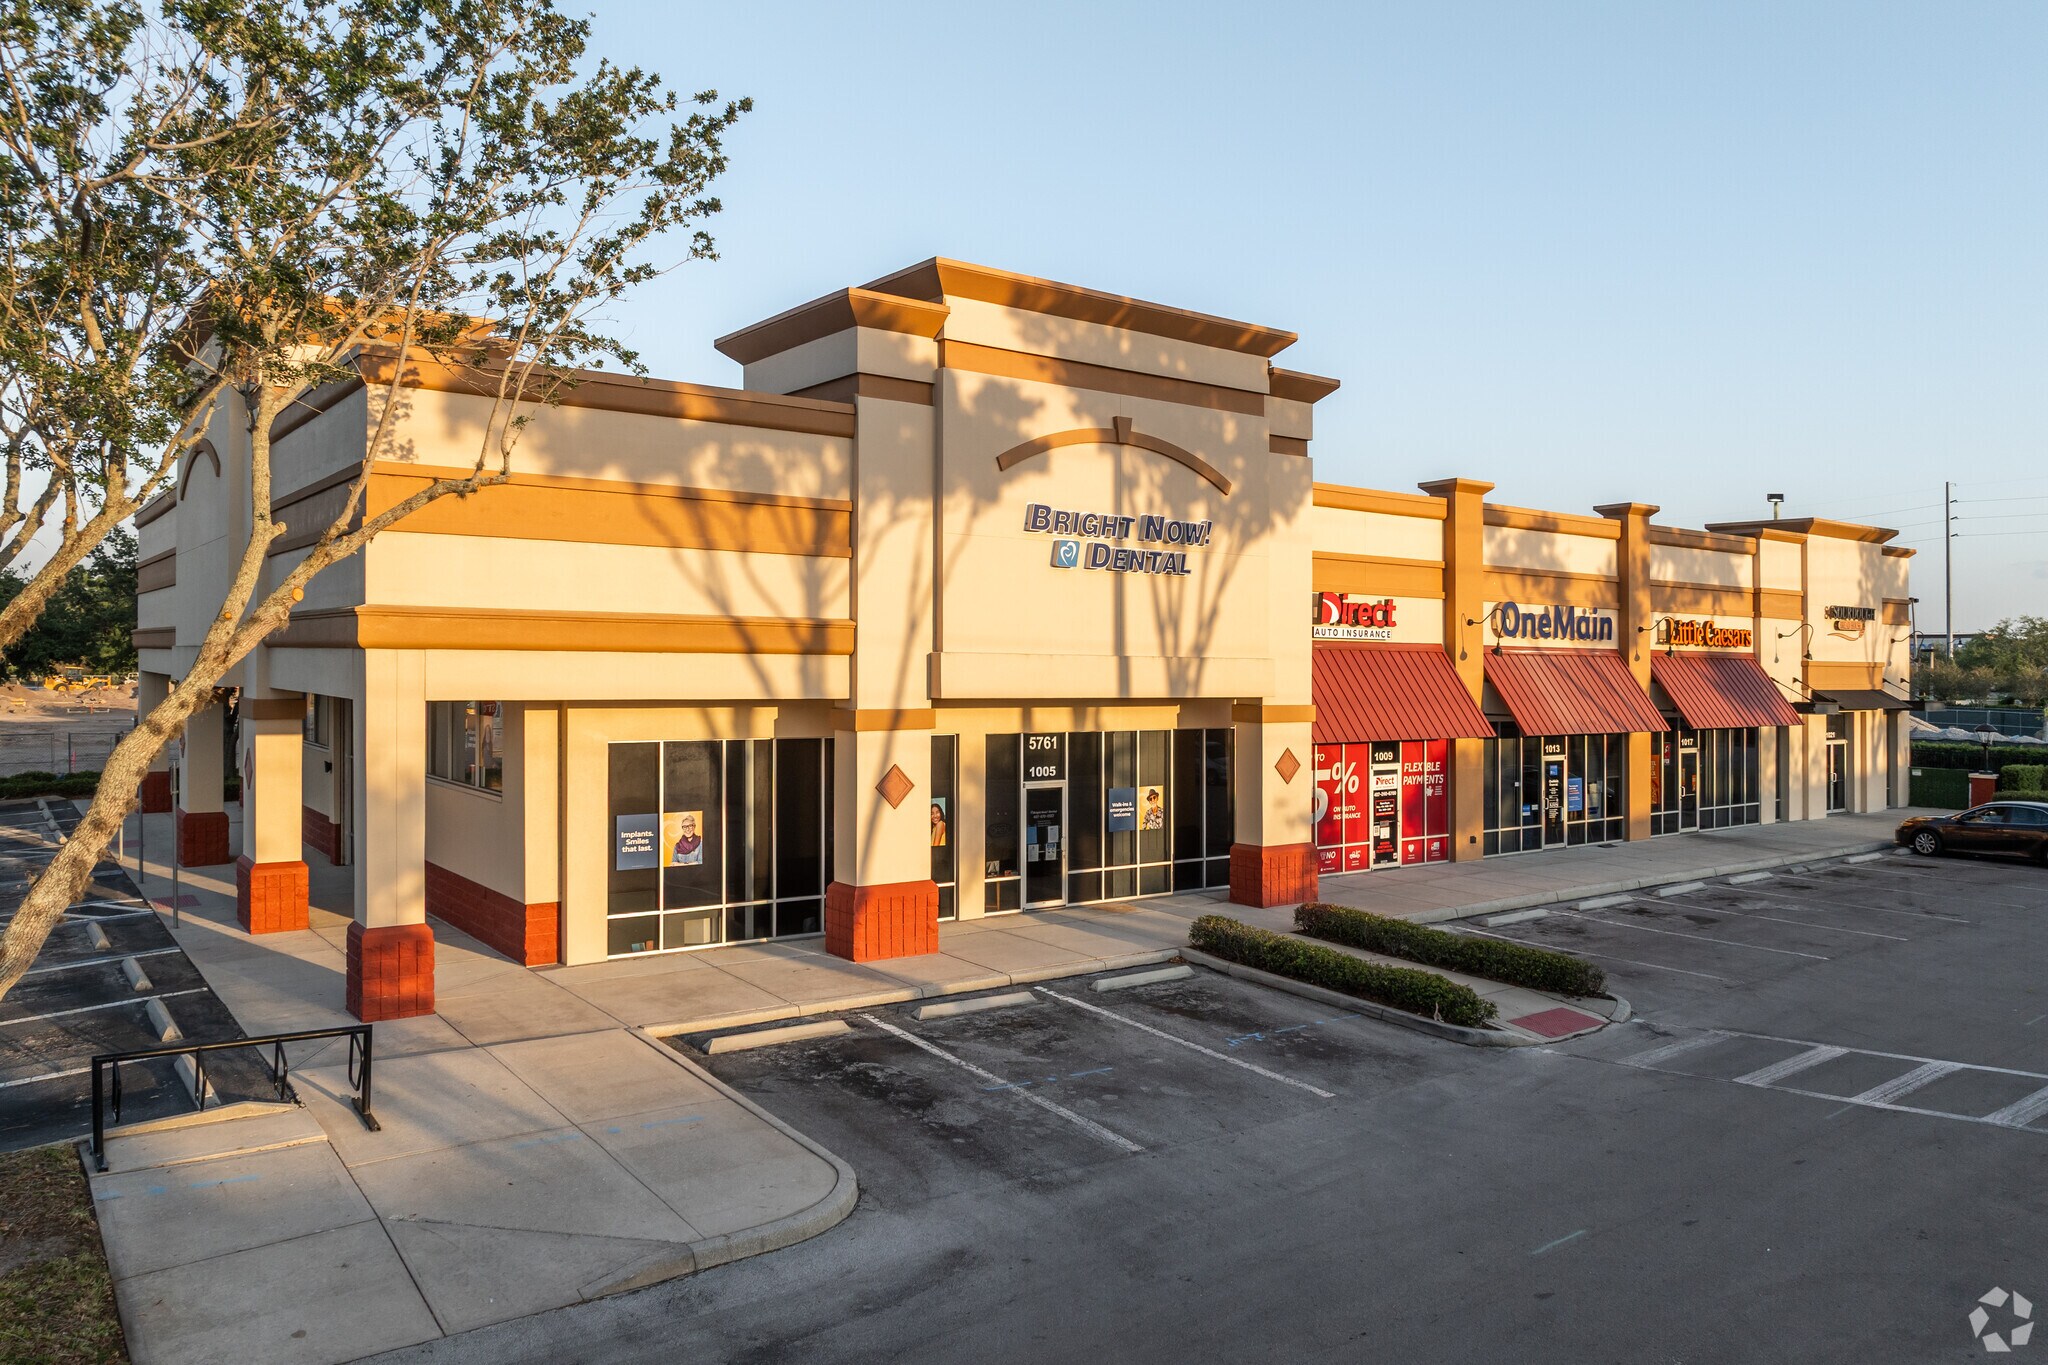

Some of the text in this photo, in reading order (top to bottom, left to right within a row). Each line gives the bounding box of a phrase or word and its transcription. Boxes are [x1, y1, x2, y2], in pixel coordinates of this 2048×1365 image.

[1086, 542, 1191, 575] DENTAL
[1321, 592, 1397, 628] Direct
[1500, 601, 1613, 641] OneMain
[1315, 628, 1391, 639] AUTO INSURANCE
[1669, 619, 1752, 647] Little Caesars
[1029, 736, 1057, 750] 5761
[1545, 745, 1560, 753] 1013
[1374, 752, 1393, 761] 1009
[1029, 766, 1056, 777] 1005
[1404, 762, 1440, 772] FLEXBLE
[1375, 776, 1395, 785] Direct
[1403, 774, 1444, 786] PAYMENTS
[1333, 812, 1361, 820] INSRANCE
